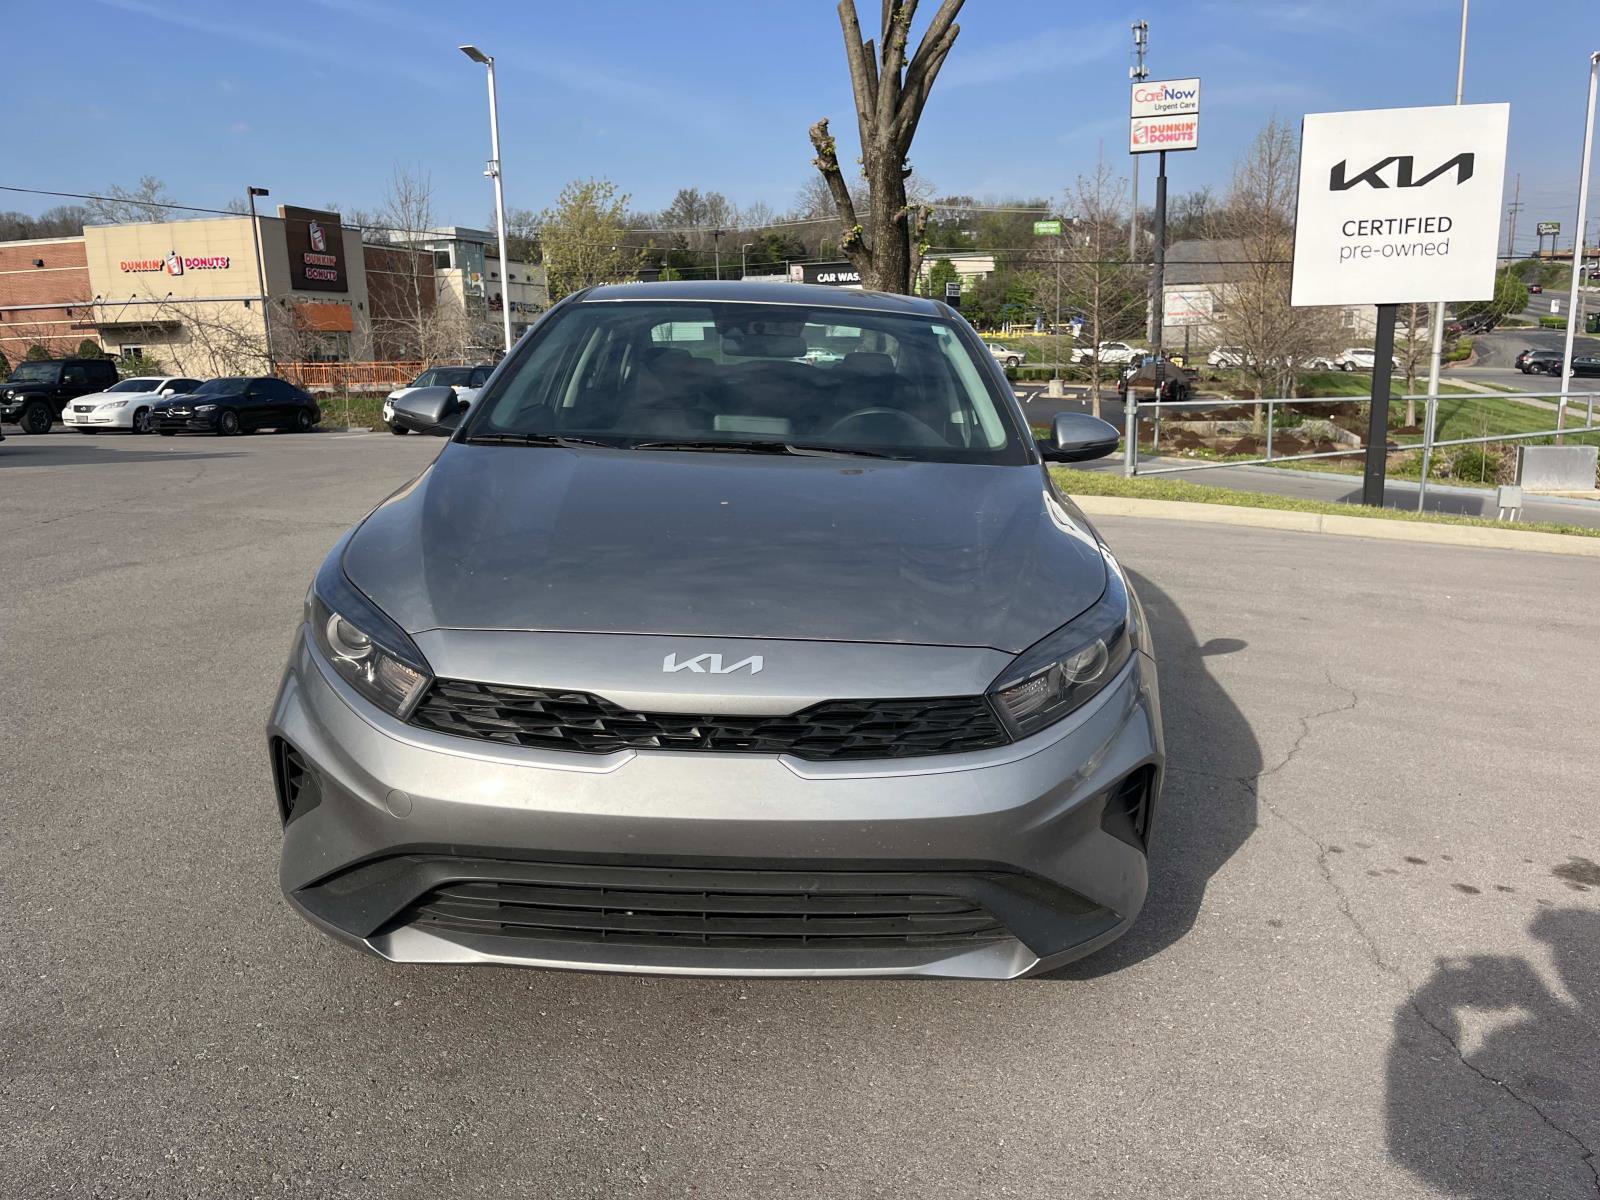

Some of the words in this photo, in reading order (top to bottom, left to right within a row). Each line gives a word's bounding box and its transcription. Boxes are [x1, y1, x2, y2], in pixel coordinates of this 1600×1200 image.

[1154, 103, 1178, 111] Urgent
[1179, 101, 1196, 109] Care
[1150, 132, 1193, 143] DONUTS
[1329, 152, 1475, 191] KIA
[1342, 216, 1453, 237] CERTIFIED
[1339, 238, 1450, 264] pre-owned
[184, 257, 229, 269] DONUTS
[306, 267, 337, 281] DONUTS
[817, 273, 836, 283] CAR
[837, 272, 860, 282] WAS
[663, 652, 763, 675] KIA
